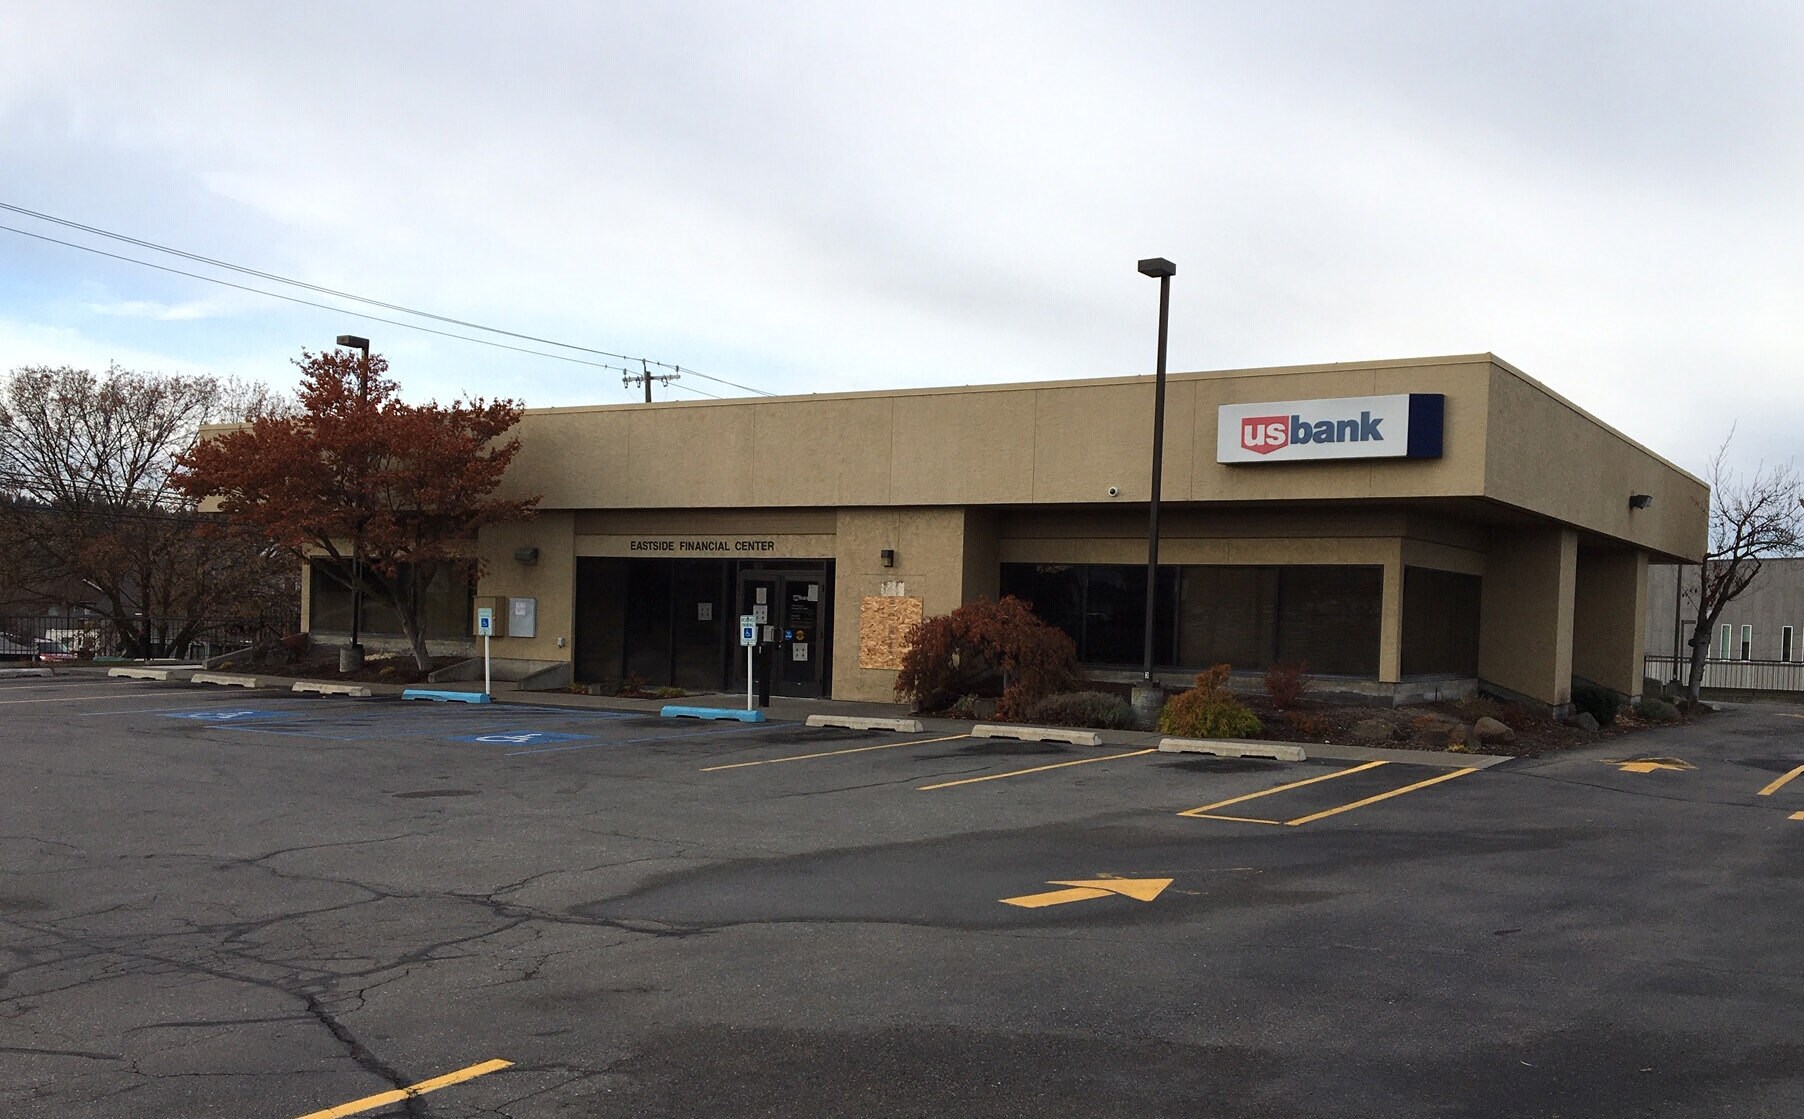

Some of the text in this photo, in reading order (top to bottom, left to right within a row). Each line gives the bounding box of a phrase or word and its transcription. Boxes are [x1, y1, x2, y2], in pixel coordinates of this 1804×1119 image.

[630, 541, 775, 551] EASTSIDE FINANCIAL CENTER
